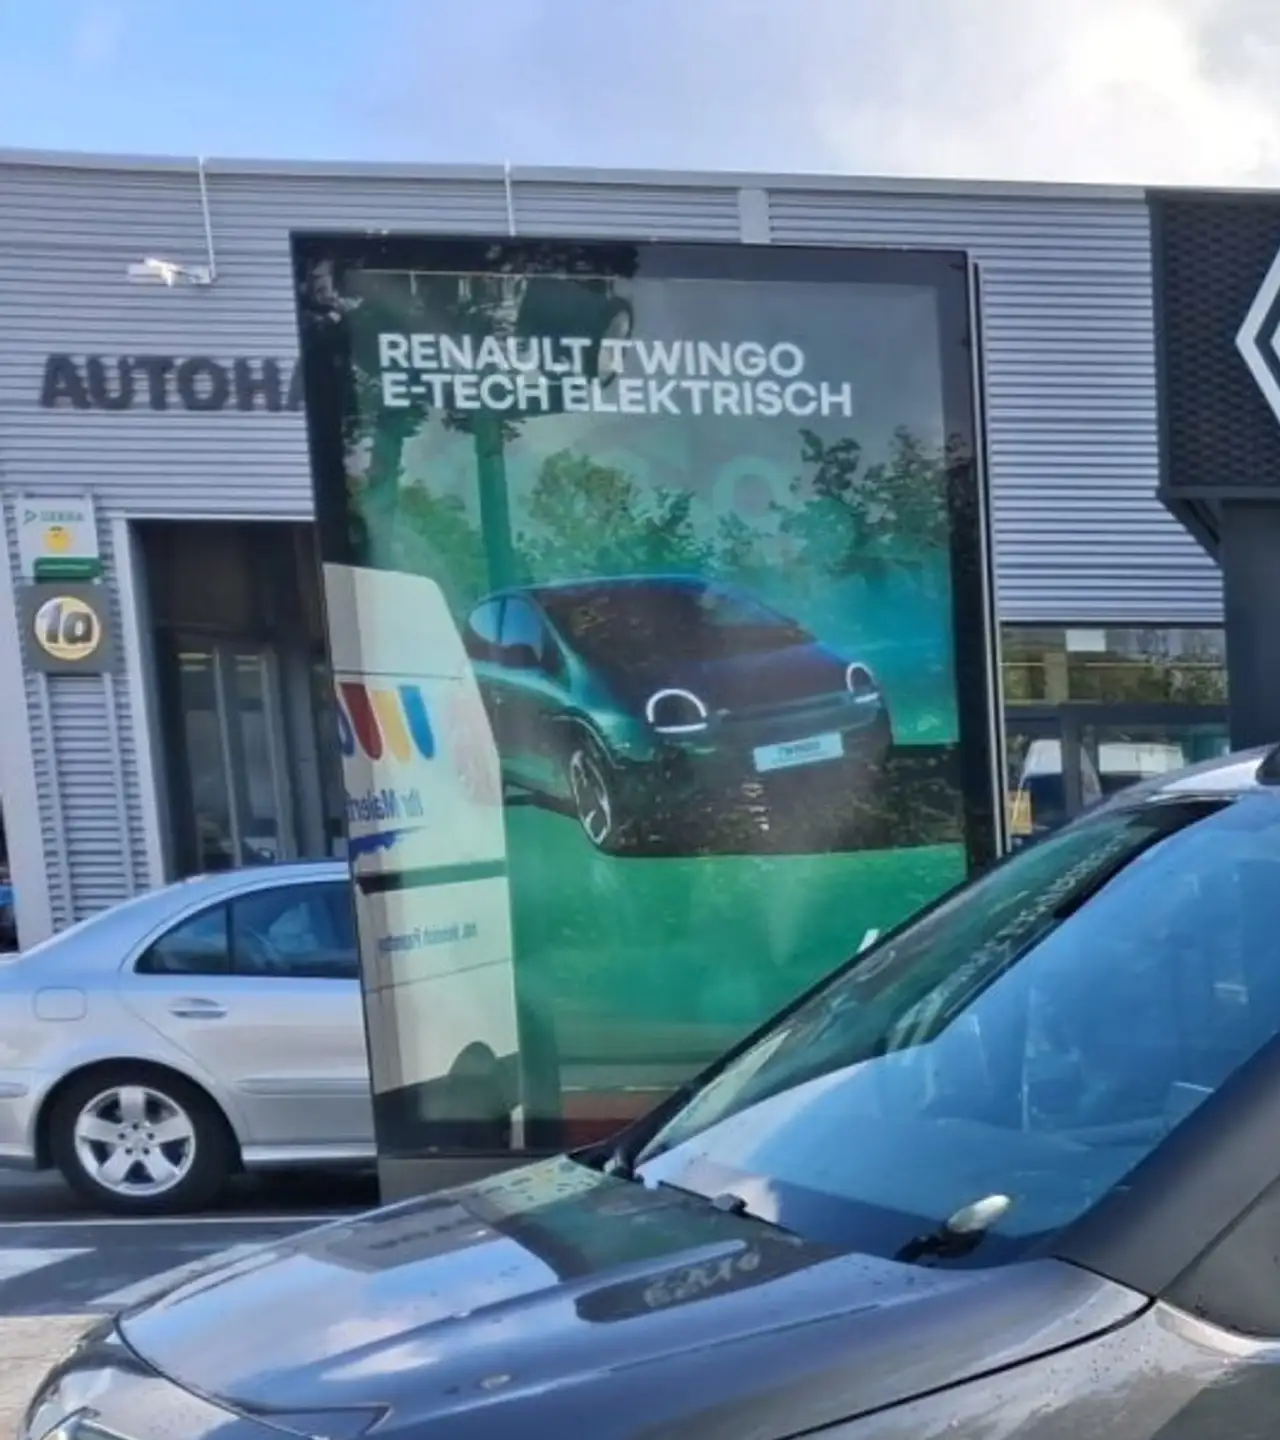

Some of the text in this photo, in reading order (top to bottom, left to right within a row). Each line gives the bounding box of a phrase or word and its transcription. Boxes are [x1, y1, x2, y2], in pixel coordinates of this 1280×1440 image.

[378, 333, 805, 378] RENAULT TWINGO
[382, 372, 853, 418] E-TECH ELEKTRISCH
